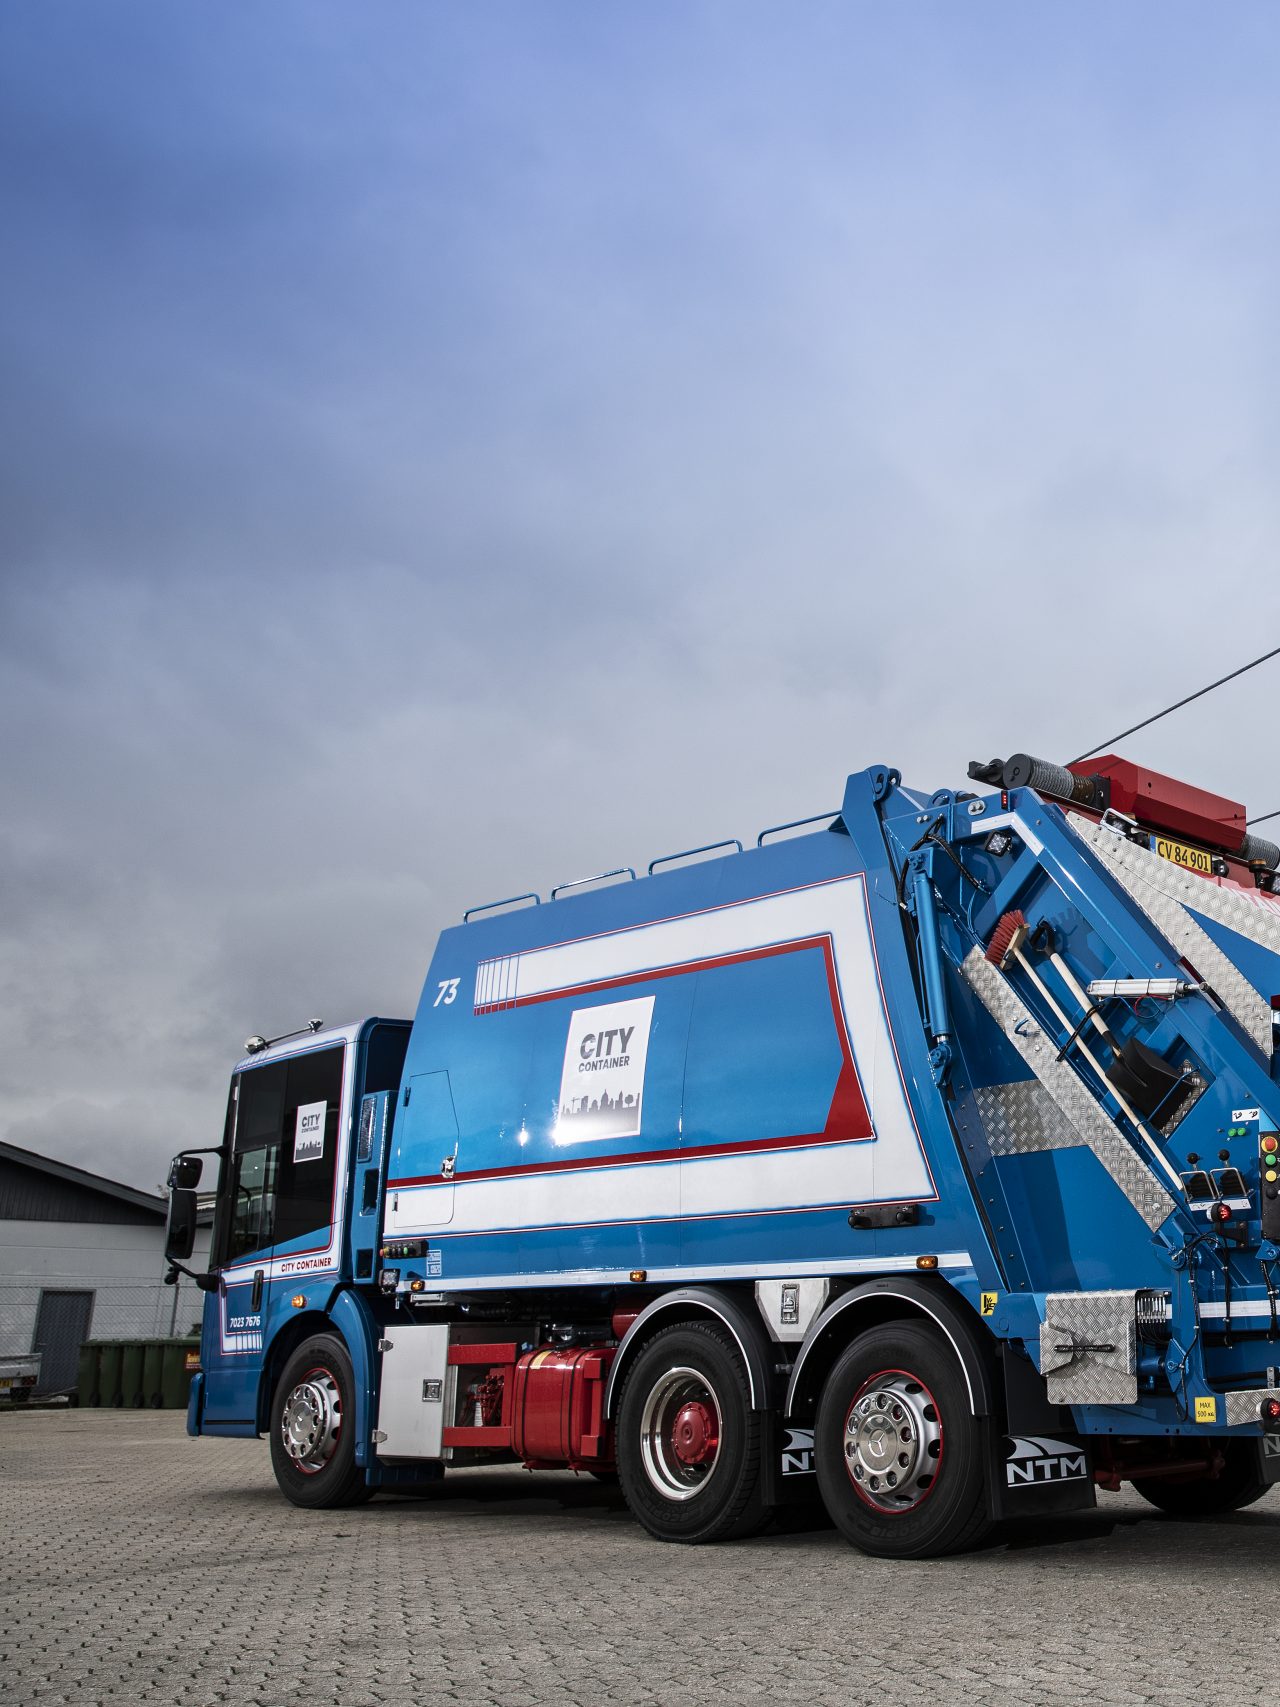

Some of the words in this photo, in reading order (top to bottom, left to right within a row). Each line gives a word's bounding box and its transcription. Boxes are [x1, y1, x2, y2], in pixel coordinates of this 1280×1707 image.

[1157, 840, 1172, 860] CV
[1174, 846, 1188, 865] 84
[1190, 851, 1209, 872] 901
[433, 977, 461, 1008] 73
[580, 1026, 635, 1060] CITY
[578, 1055, 630, 1073] CONTAINER
[301, 1113, 321, 1128] CITY
[281, 1262, 296, 1273] CITY
[296, 1257, 332, 1270] CONTAINER
[230, 1316, 245, 1328] 7023
[245, 1315, 261, 1327] 7676
[1006, 1455, 1087, 1484] NTM
